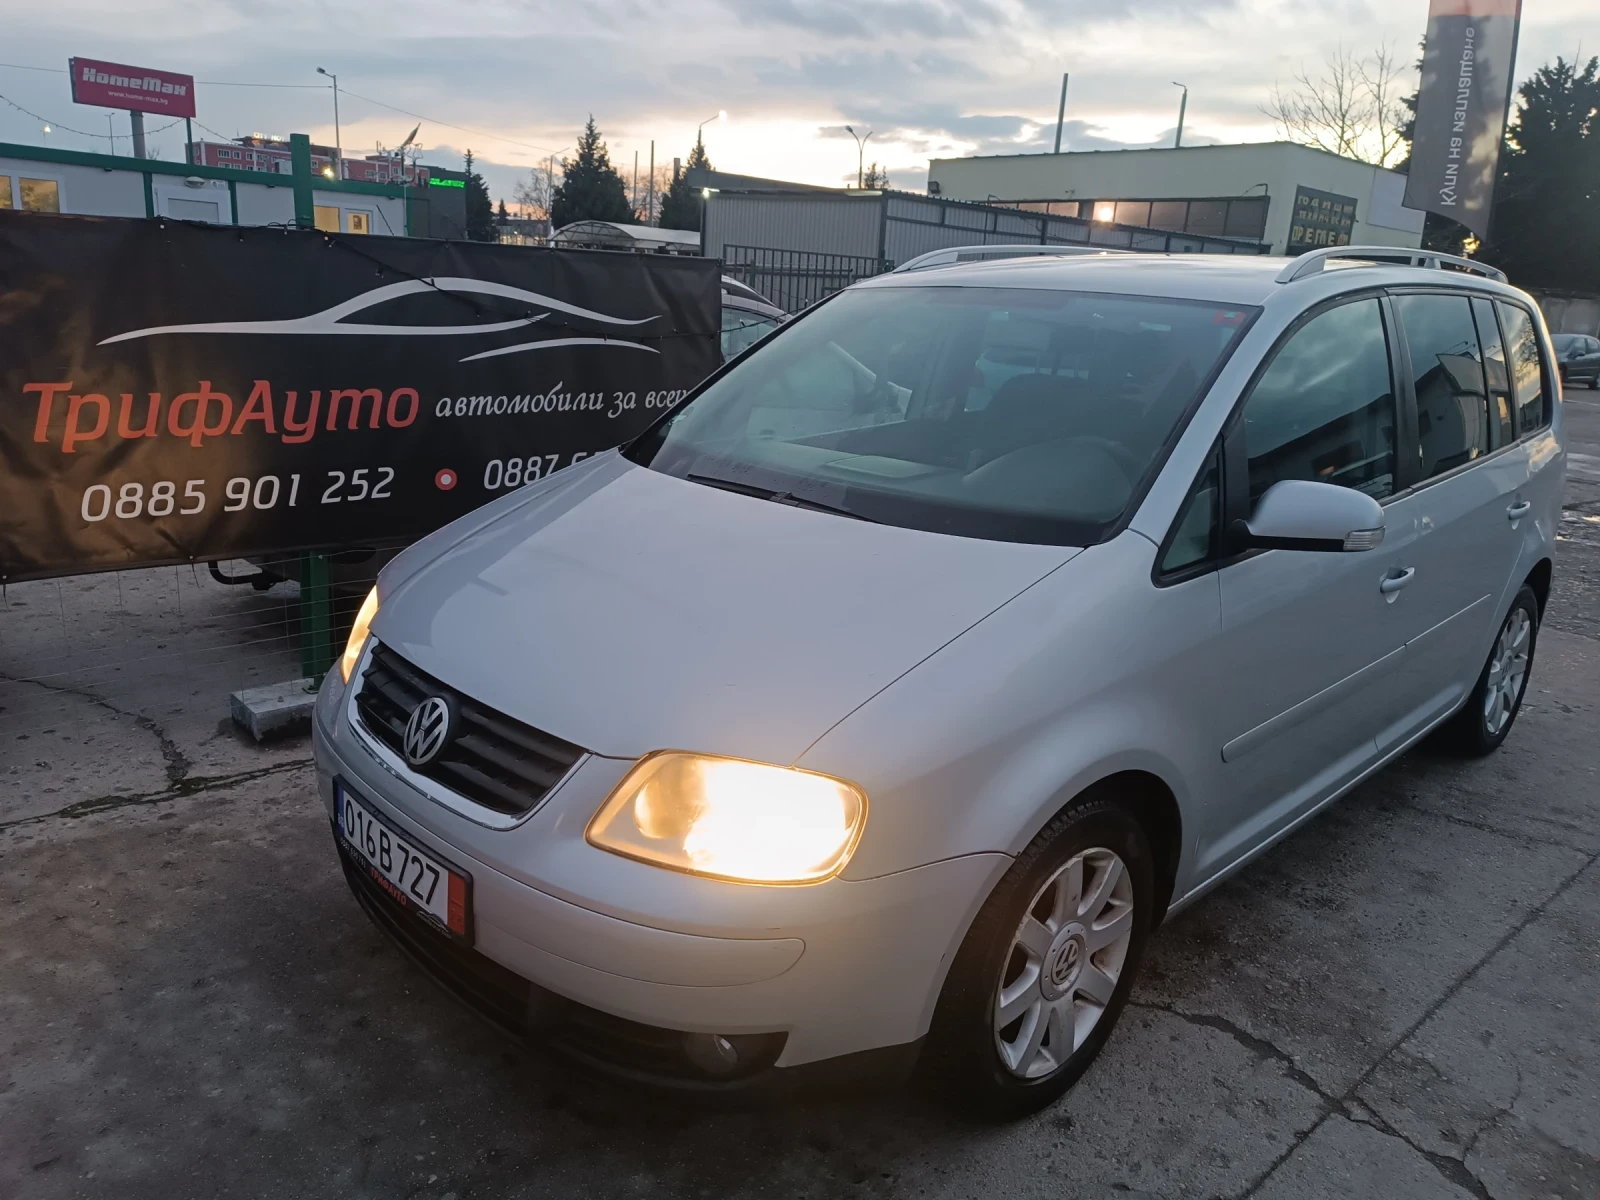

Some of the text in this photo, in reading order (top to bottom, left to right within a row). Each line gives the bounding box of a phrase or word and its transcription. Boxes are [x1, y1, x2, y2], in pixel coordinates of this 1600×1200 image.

[22, 380, 419, 453] ТрифАуто
[435, 381, 604, 417] автомобили
[607, 391, 637, 419] за
[81, 479, 206, 522] 0885
[223, 474, 301, 511] 901
[321, 467, 395, 504] 252
[484, 454, 560, 490] 0887
